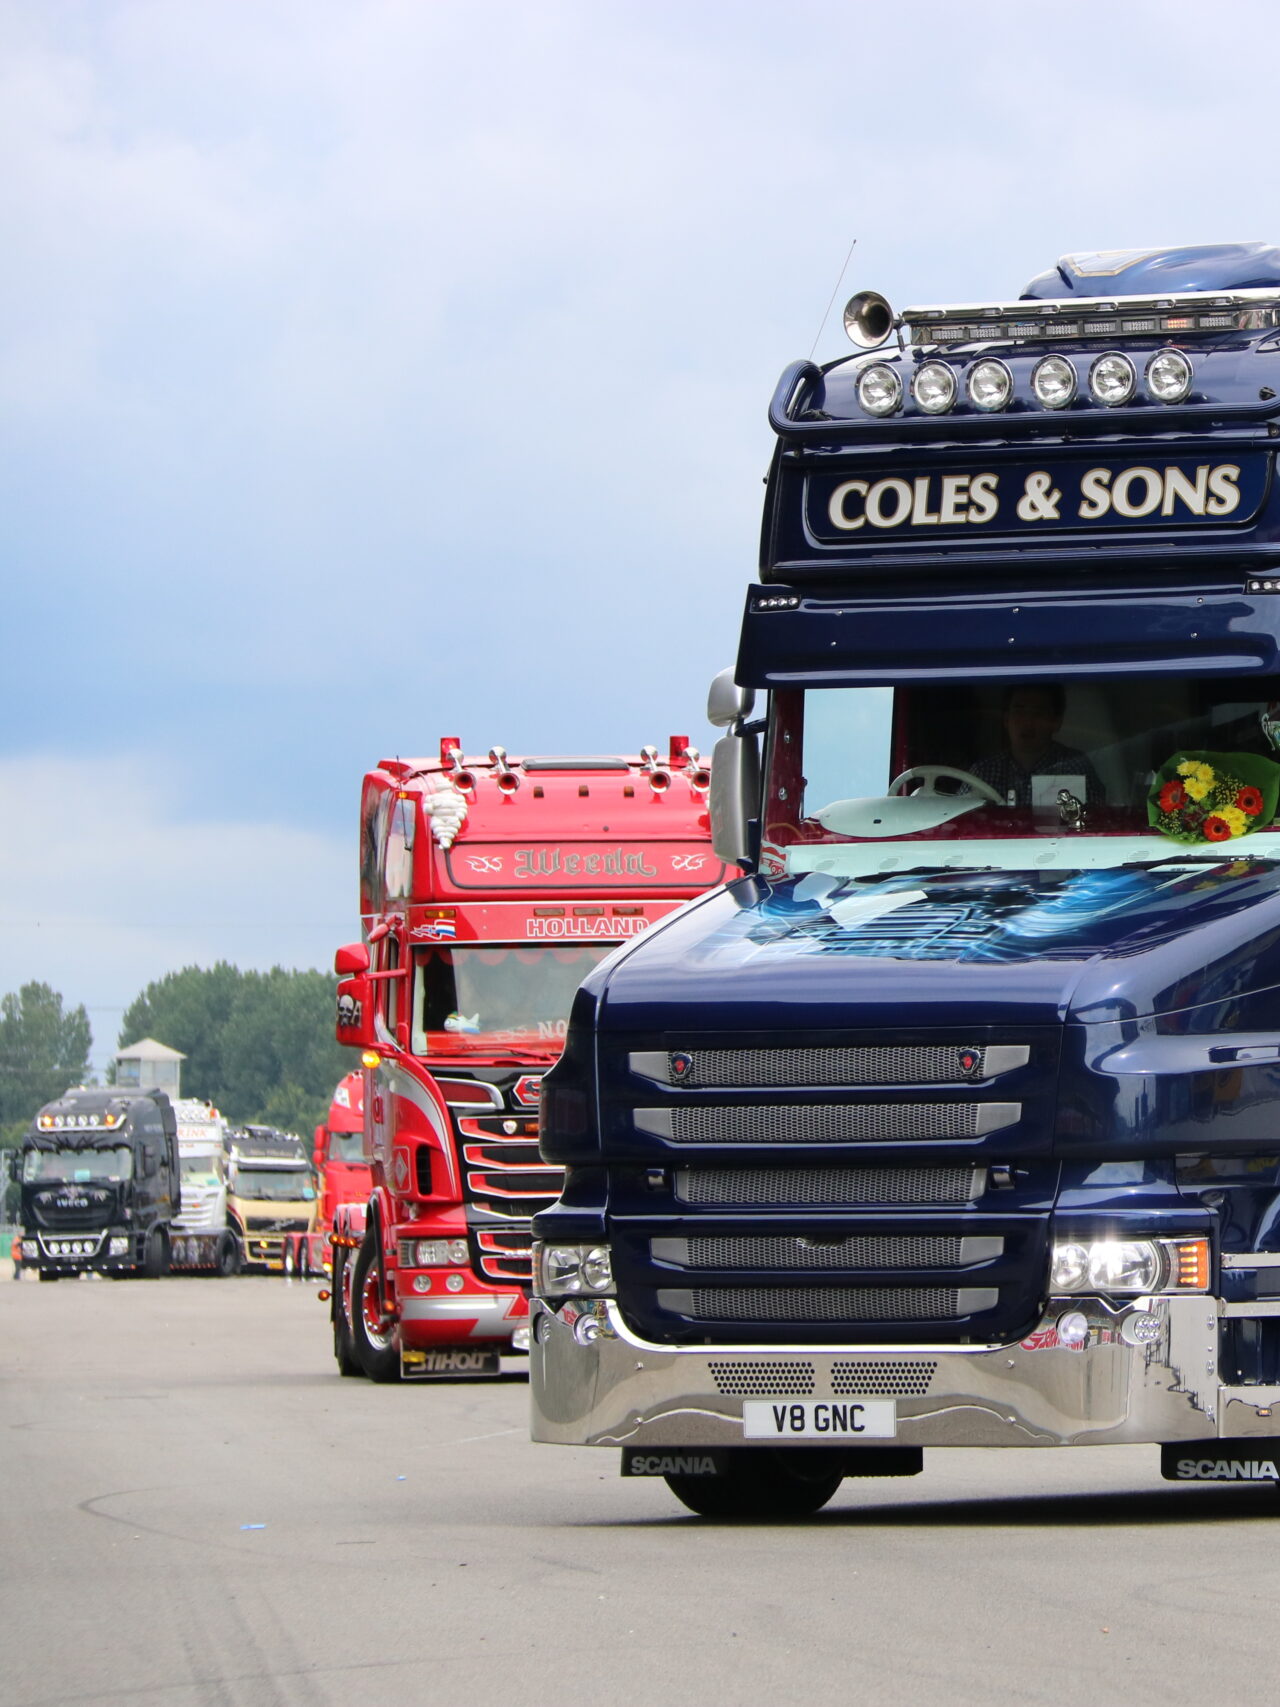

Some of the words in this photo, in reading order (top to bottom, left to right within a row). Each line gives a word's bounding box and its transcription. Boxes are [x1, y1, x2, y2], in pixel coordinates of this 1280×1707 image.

[828, 473, 999, 531] COLES
[1016, 471, 1062, 521] &
[1078, 464, 1241, 519] SONS
[514, 848, 657, 878] Weeda
[526, 917, 649, 936] HOLLAND
[772, 1404, 805, 1433] V8
[814, 1404, 865, 1433] GNC
[631, 1456, 717, 1475] SCANIA
[1177, 1459, 1280, 1479] SCANIA
